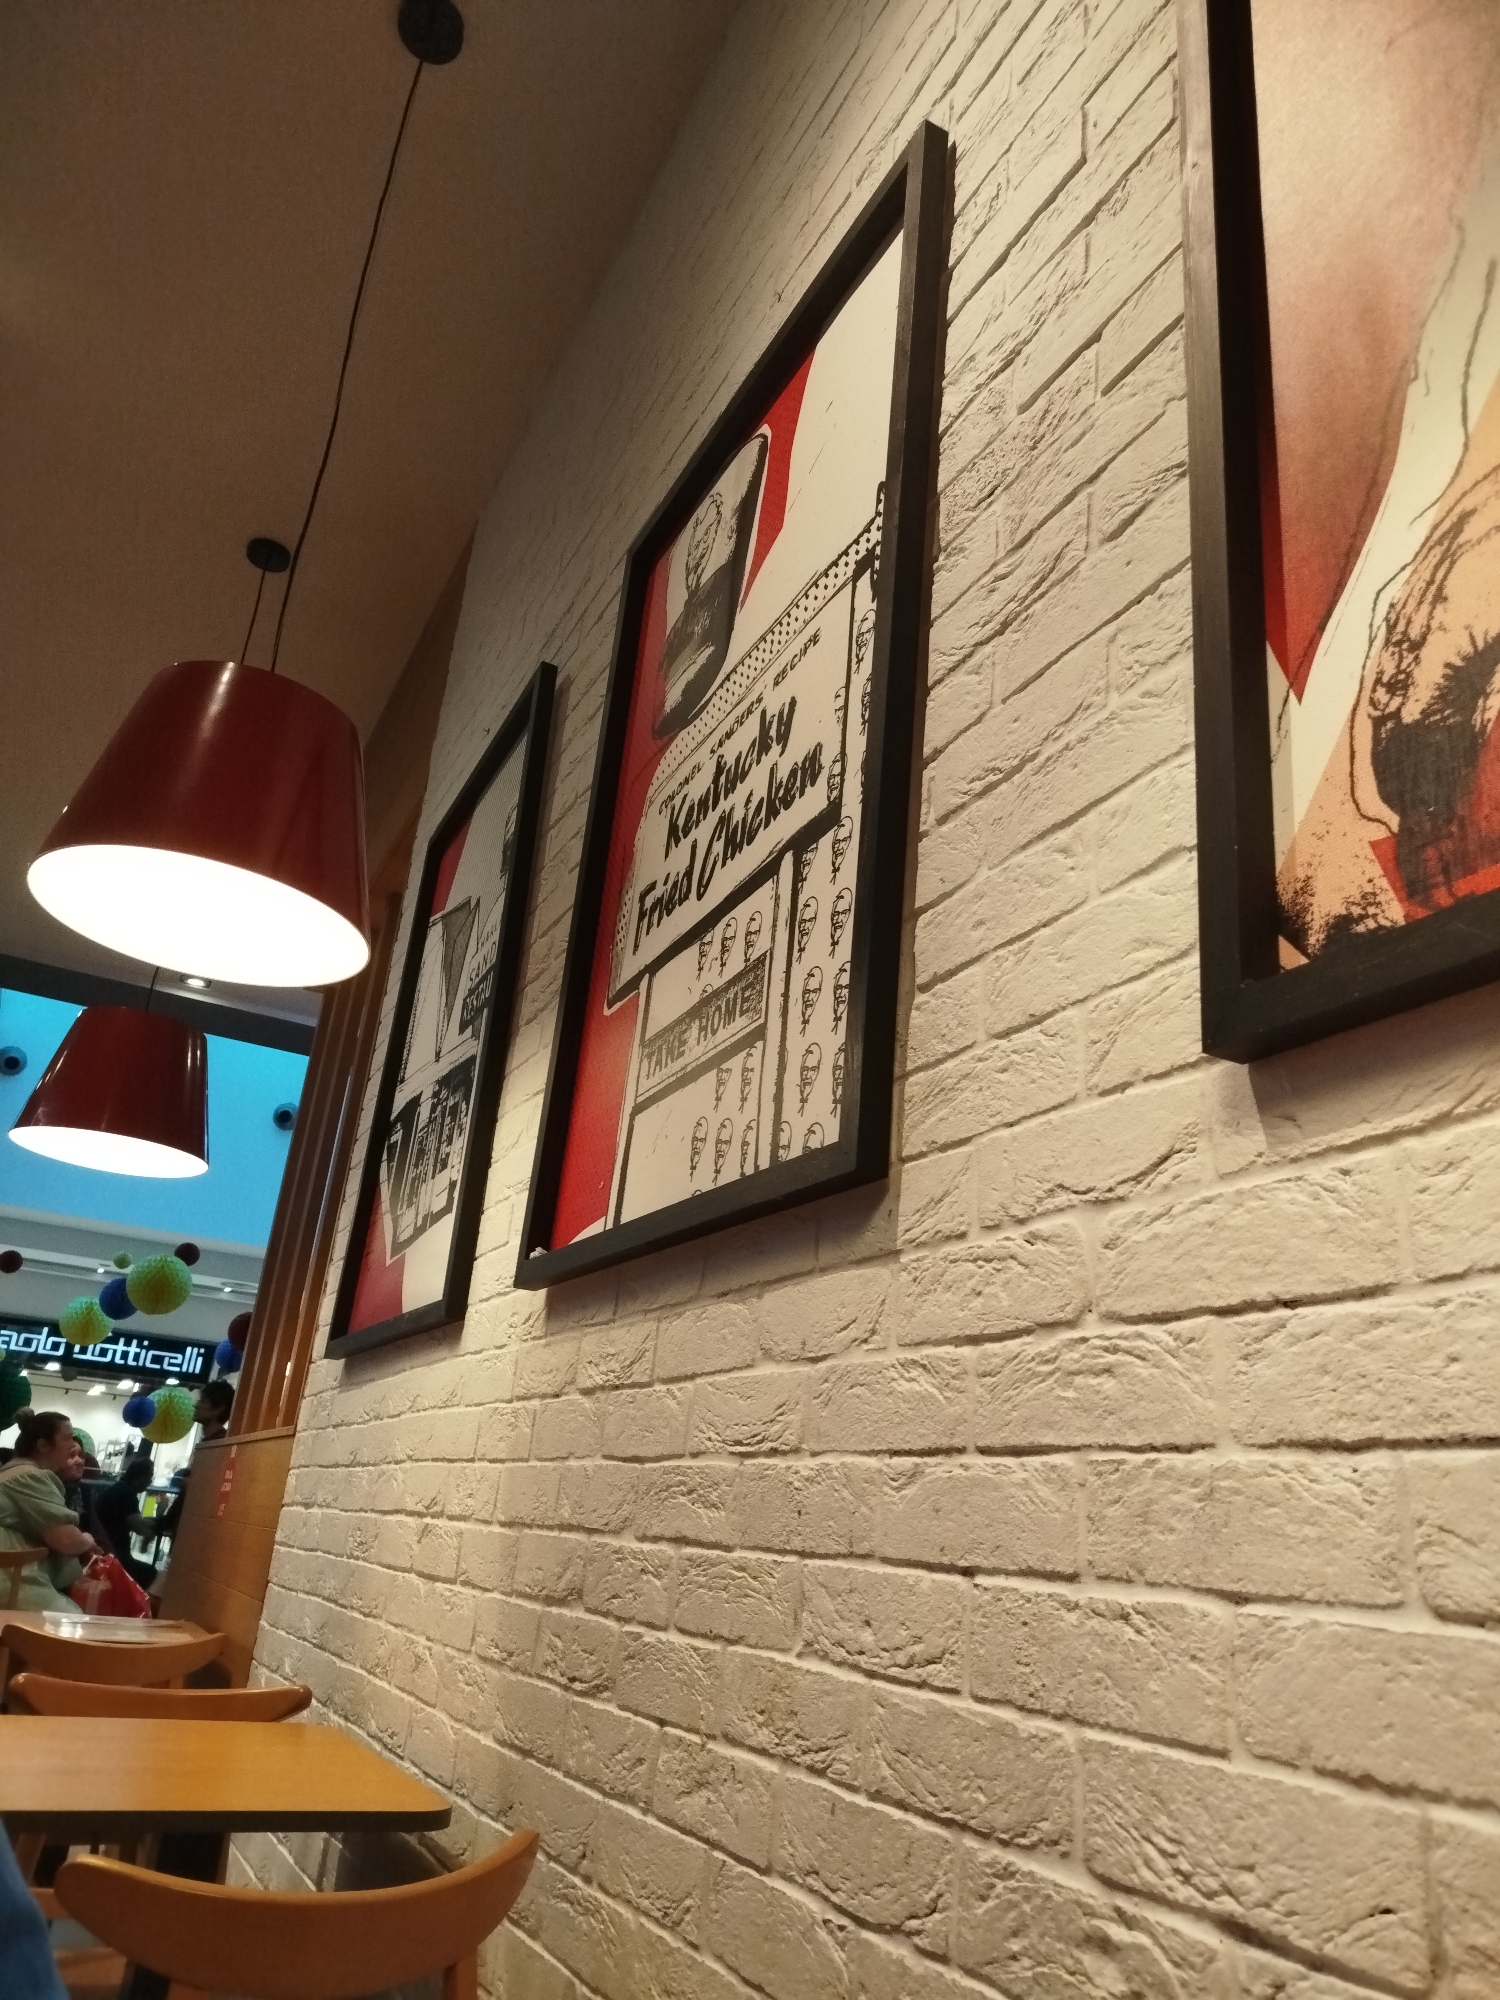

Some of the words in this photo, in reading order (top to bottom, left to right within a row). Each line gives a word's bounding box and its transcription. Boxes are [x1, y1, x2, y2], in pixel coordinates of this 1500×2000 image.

[772, 627, 822, 691] RECIPE
[664, 695, 798, 862] Kentucky
[632, 838, 698, 956] Fried
[697, 741, 825, 902] Chicken
[642, 1032, 688, 1082] TAKE
[697, 985, 760, 1047] HOME
